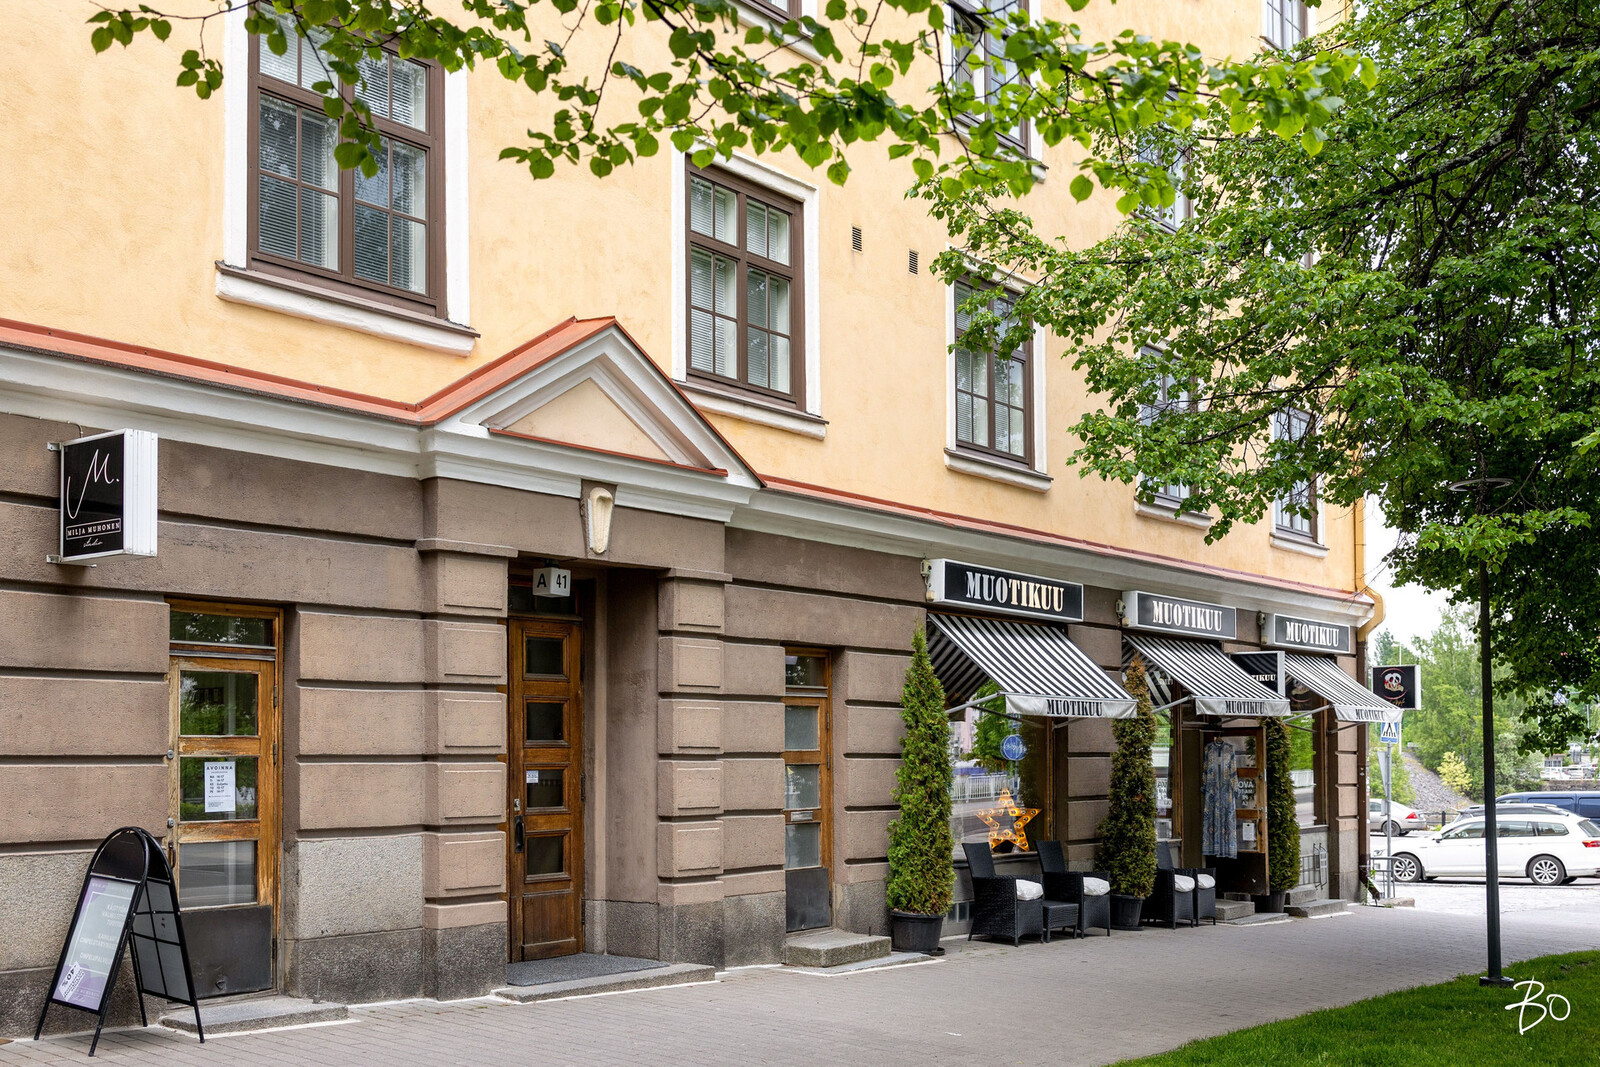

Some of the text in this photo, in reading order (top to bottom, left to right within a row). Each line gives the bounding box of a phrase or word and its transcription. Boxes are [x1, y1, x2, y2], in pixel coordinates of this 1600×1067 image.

[67, 522, 120, 536] MILJA MUHONEN
[537, 573, 547, 588] A
[556, 574, 567, 589] 41
[965, 571, 1065, 612] MUOTIKUU
[1152, 600, 1223, 632] MUOTIKUU
[1286, 621, 1340, 647] MUOTIKUU
[1046, 699, 1103, 717] MUOTIKUU
[1225, 700, 1265, 714] MUOTIKUU
[1355, 708, 1385, 721] MUOTIKUU
